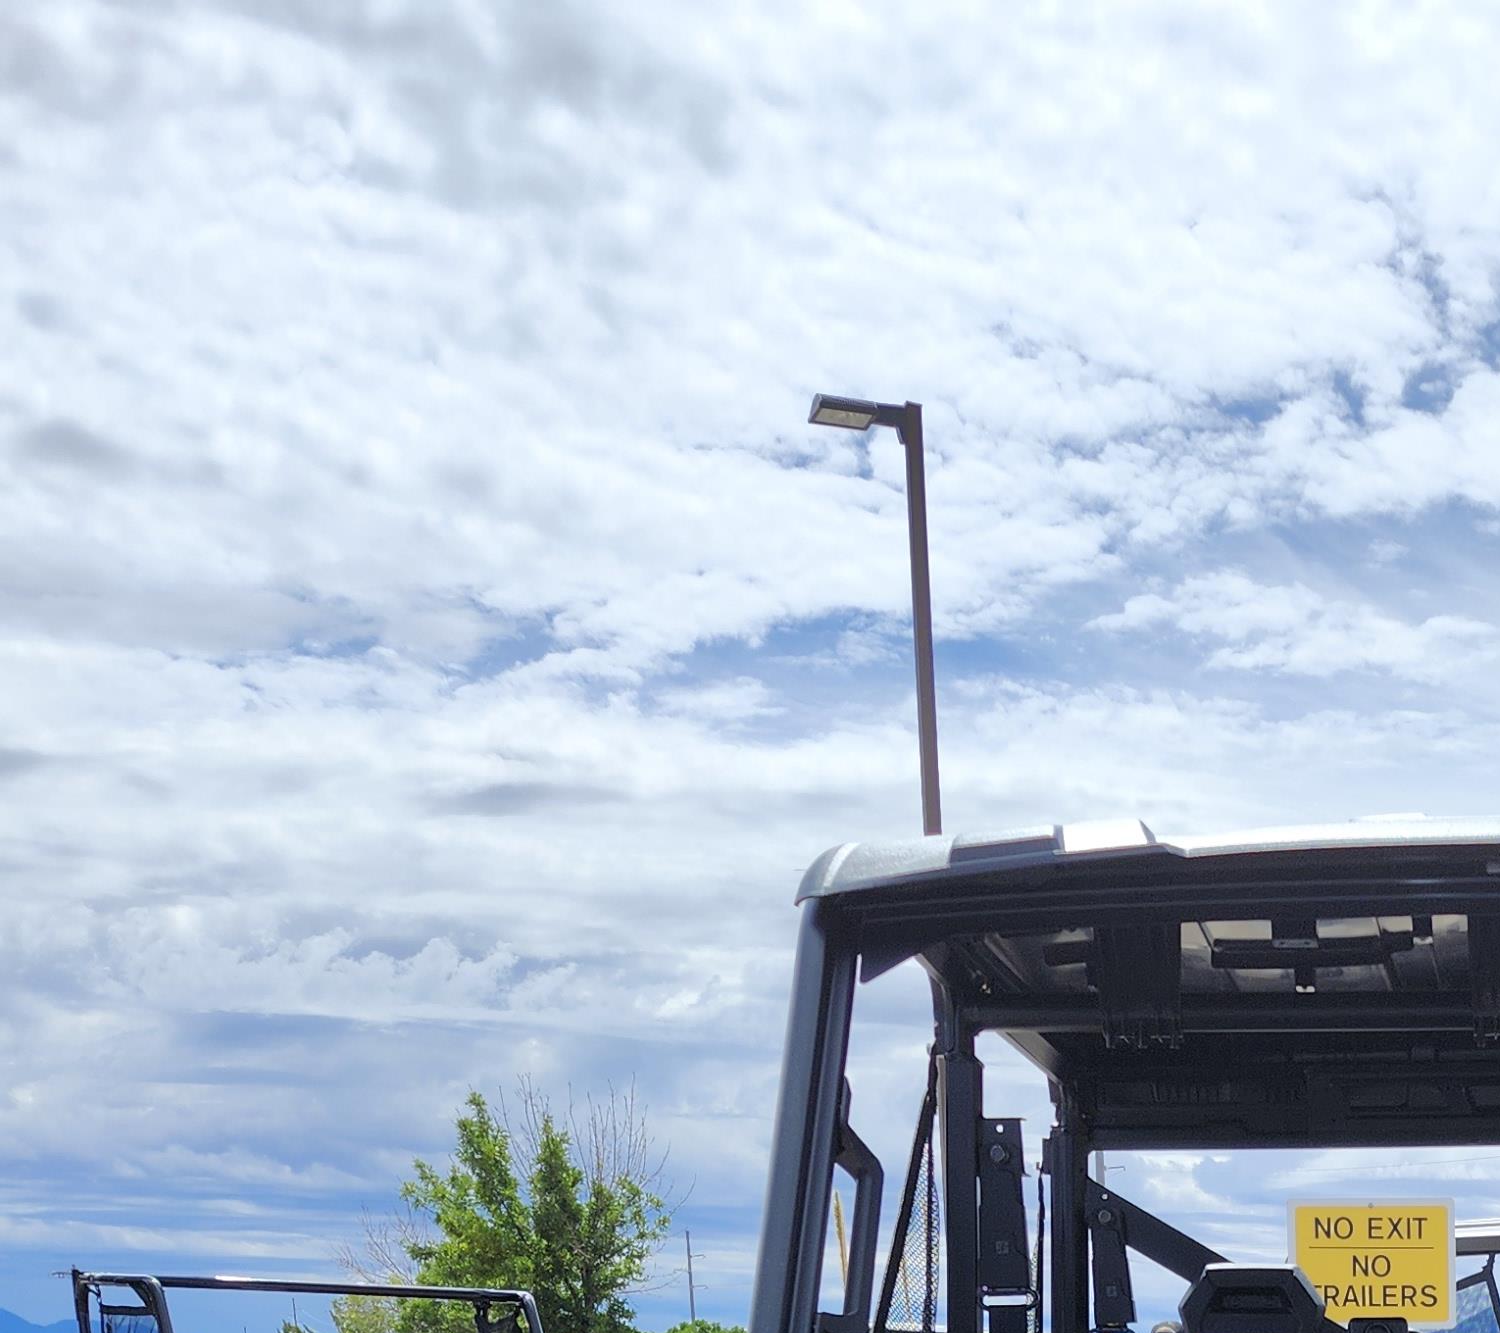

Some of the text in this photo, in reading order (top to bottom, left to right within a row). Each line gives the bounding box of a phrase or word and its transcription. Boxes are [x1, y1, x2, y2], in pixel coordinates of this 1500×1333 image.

[1314, 1216, 1428, 1239] NO EXIT
[1352, 1254, 1391, 1277] NO
